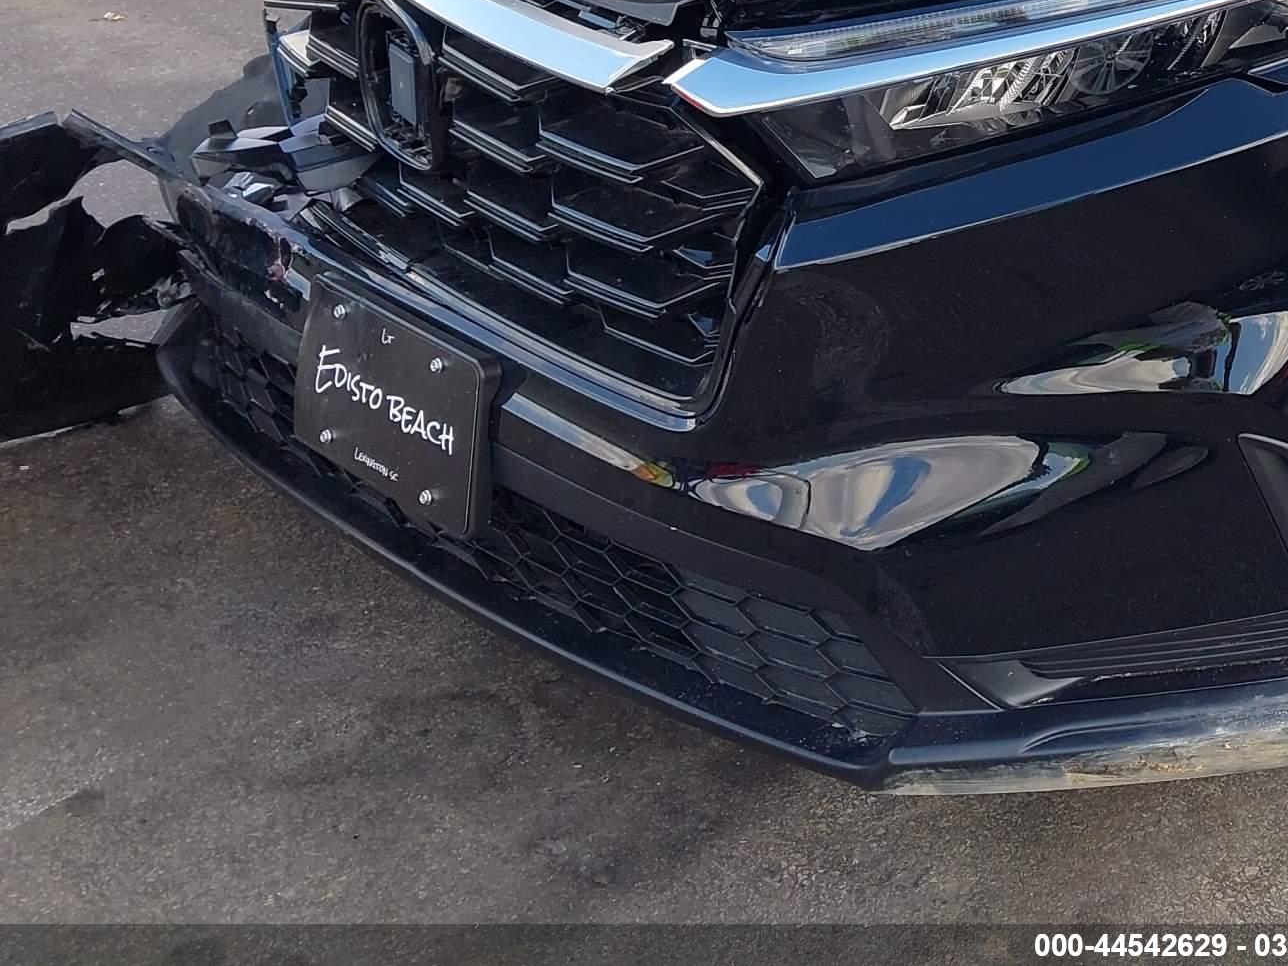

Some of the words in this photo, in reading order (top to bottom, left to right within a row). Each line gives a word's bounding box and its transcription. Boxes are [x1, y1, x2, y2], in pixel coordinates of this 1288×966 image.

[315, 345, 383, 410] EDISTO
[386, 395, 454, 456] BEACH
[354, 447, 389, 477] LEXINGTON
[389, 470, 399, 482] SC
